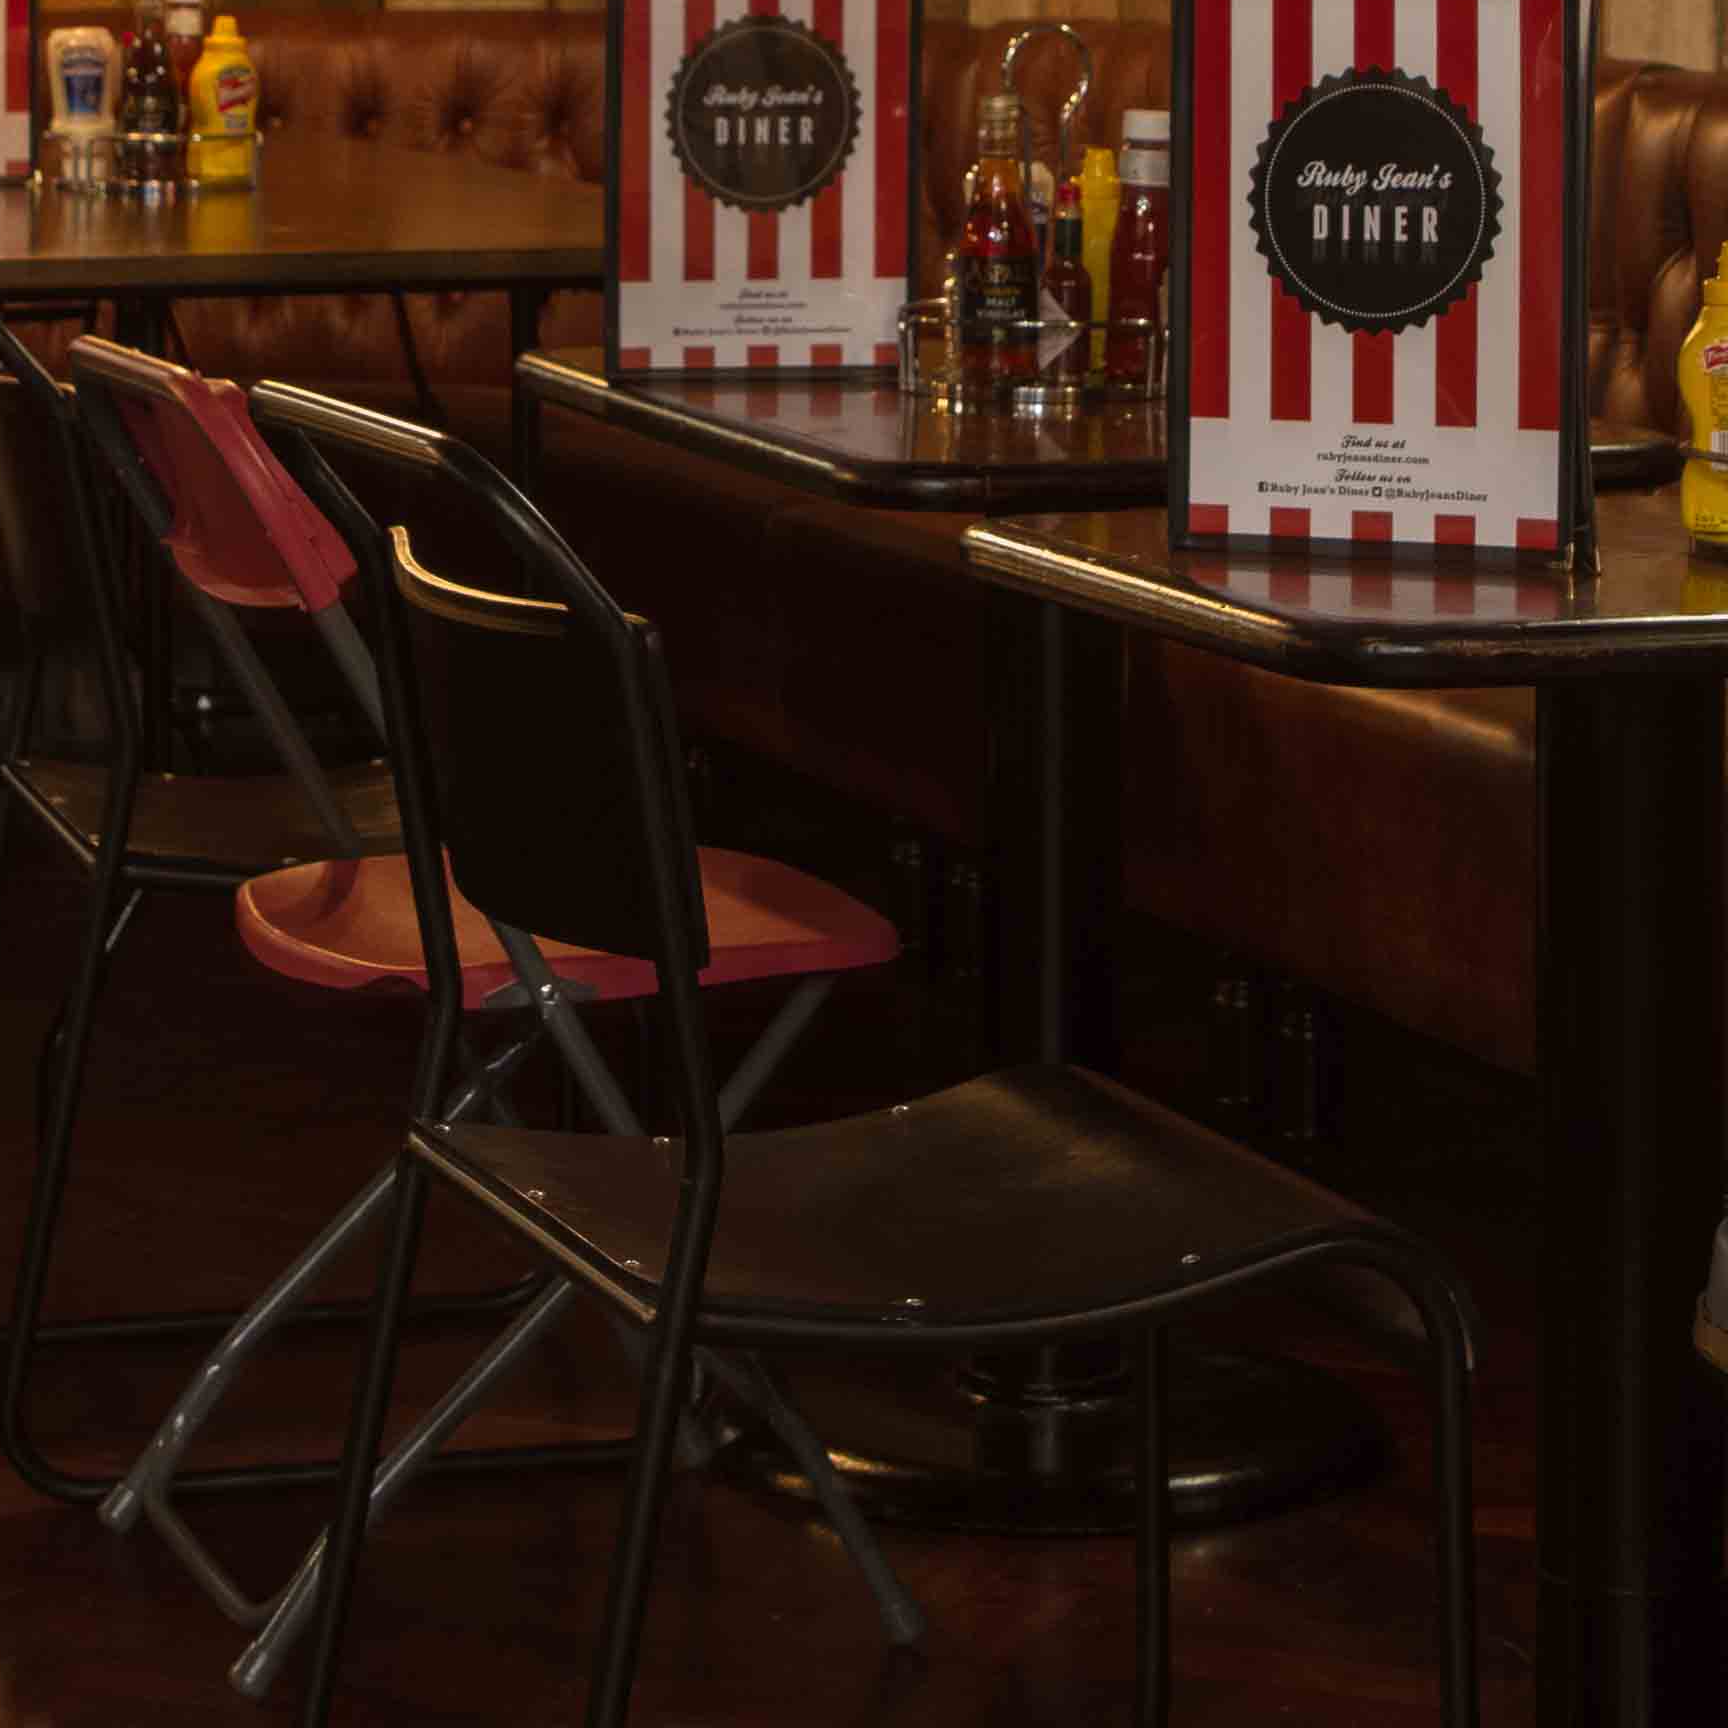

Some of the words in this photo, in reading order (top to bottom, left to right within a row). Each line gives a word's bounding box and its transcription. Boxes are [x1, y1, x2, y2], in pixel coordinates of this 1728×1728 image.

[701, 83, 758, 112] Ruby
[714, 115, 816, 146] DINER
[1295, 159, 1368, 197] Ruby
[1372, 161, 1454, 192] Jean's
[1312, 204, 1441, 244] DINER
[1341, 434, 1372, 450] Find
[1375, 440, 1388, 449] us
[1392, 439, 1406, 449] at
[1270, 482, 1299, 496] Ruby
[1302, 483, 1335, 497] Jean's
[1338, 485, 1370, 497] Diner
[1334, 468, 1376, 483] Follow
[1379, 475, 1392, 483] us
[1397, 475, 1411, 484] on
